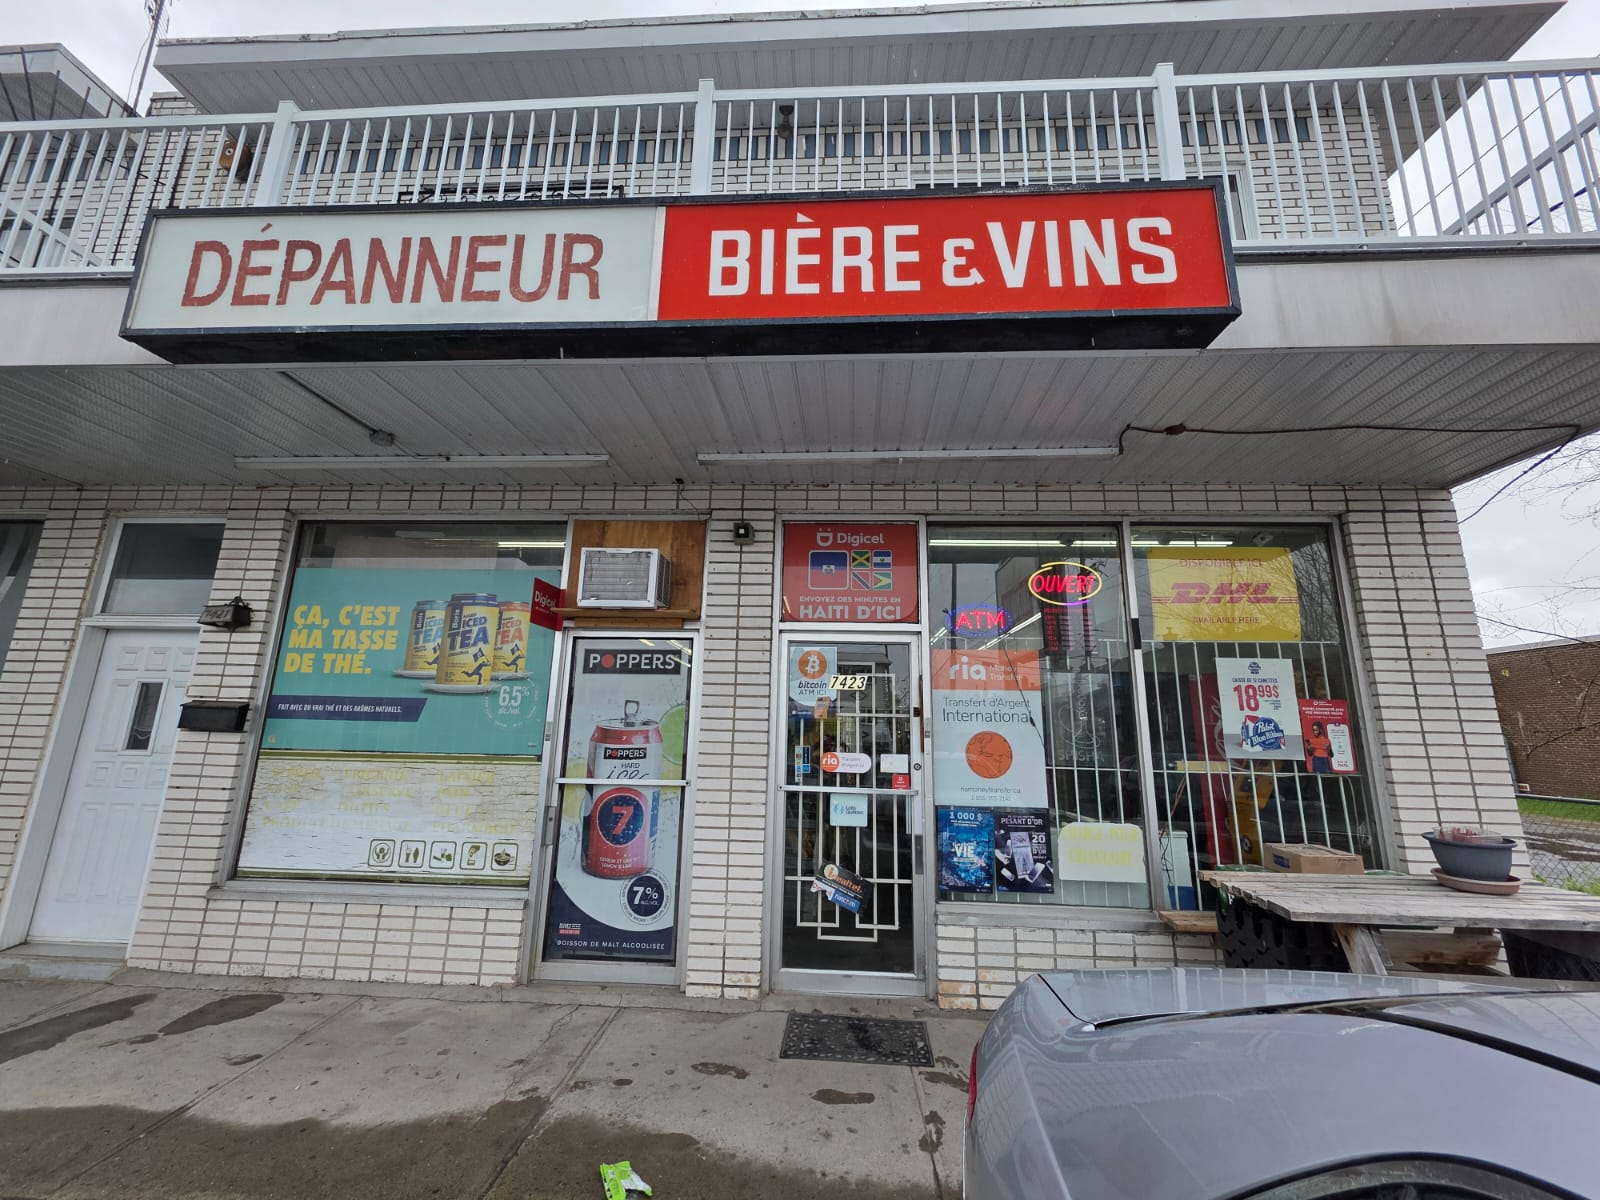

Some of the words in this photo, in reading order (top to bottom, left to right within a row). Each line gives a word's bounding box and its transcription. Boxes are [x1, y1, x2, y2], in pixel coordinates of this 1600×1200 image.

[708, 212, 921, 297] BIÈRE
[941, 238, 985, 287] &
[985, 216, 1178, 289] VINS
[181, 223, 603, 307] DÉPANNEUR
[836, 533, 885, 547] Digicel
[1031, 575, 1096, 593] OUVERT
[1171, 582, 1279, 604] DHL
[294, 604, 330, 629] ÇA,
[339, 604, 400, 626] C'EST
[799, 605, 849, 619] HAITI
[856, 606, 901, 620] D'ICI
[956, 611, 1006, 630] ATM
[462, 616, 488, 630] ICED
[288, 629, 323, 649] MA
[331, 629, 398, 651] TASSE
[447, 626, 489, 651] TEA
[284, 653, 316, 673] DE
[322, 649, 372, 674] THÉ.
[589, 653, 675, 669] POPPERS
[949, 655, 987, 680] ria
[798, 681, 827, 689] bitcoin
[830, 676, 865, 689] 7423
[278, 703, 290, 711] FAIT
[312, 704, 324, 712] VRAI
[325, 703, 334, 712] THÉ
[342, 704, 353, 712] DES
[944, 696, 986, 708] Transfert
[989, 696, 1030, 710] d'Argent
[942, 708, 1032, 724] International
[606, 750, 645, 758] POPPERS
[822, 754, 838, 765] ria
[612, 805, 634, 835] 7
[1001, 817, 1026, 825] PESANT
[1031, 834, 1046, 844] 20
[633, 886, 659, 905] 7%
